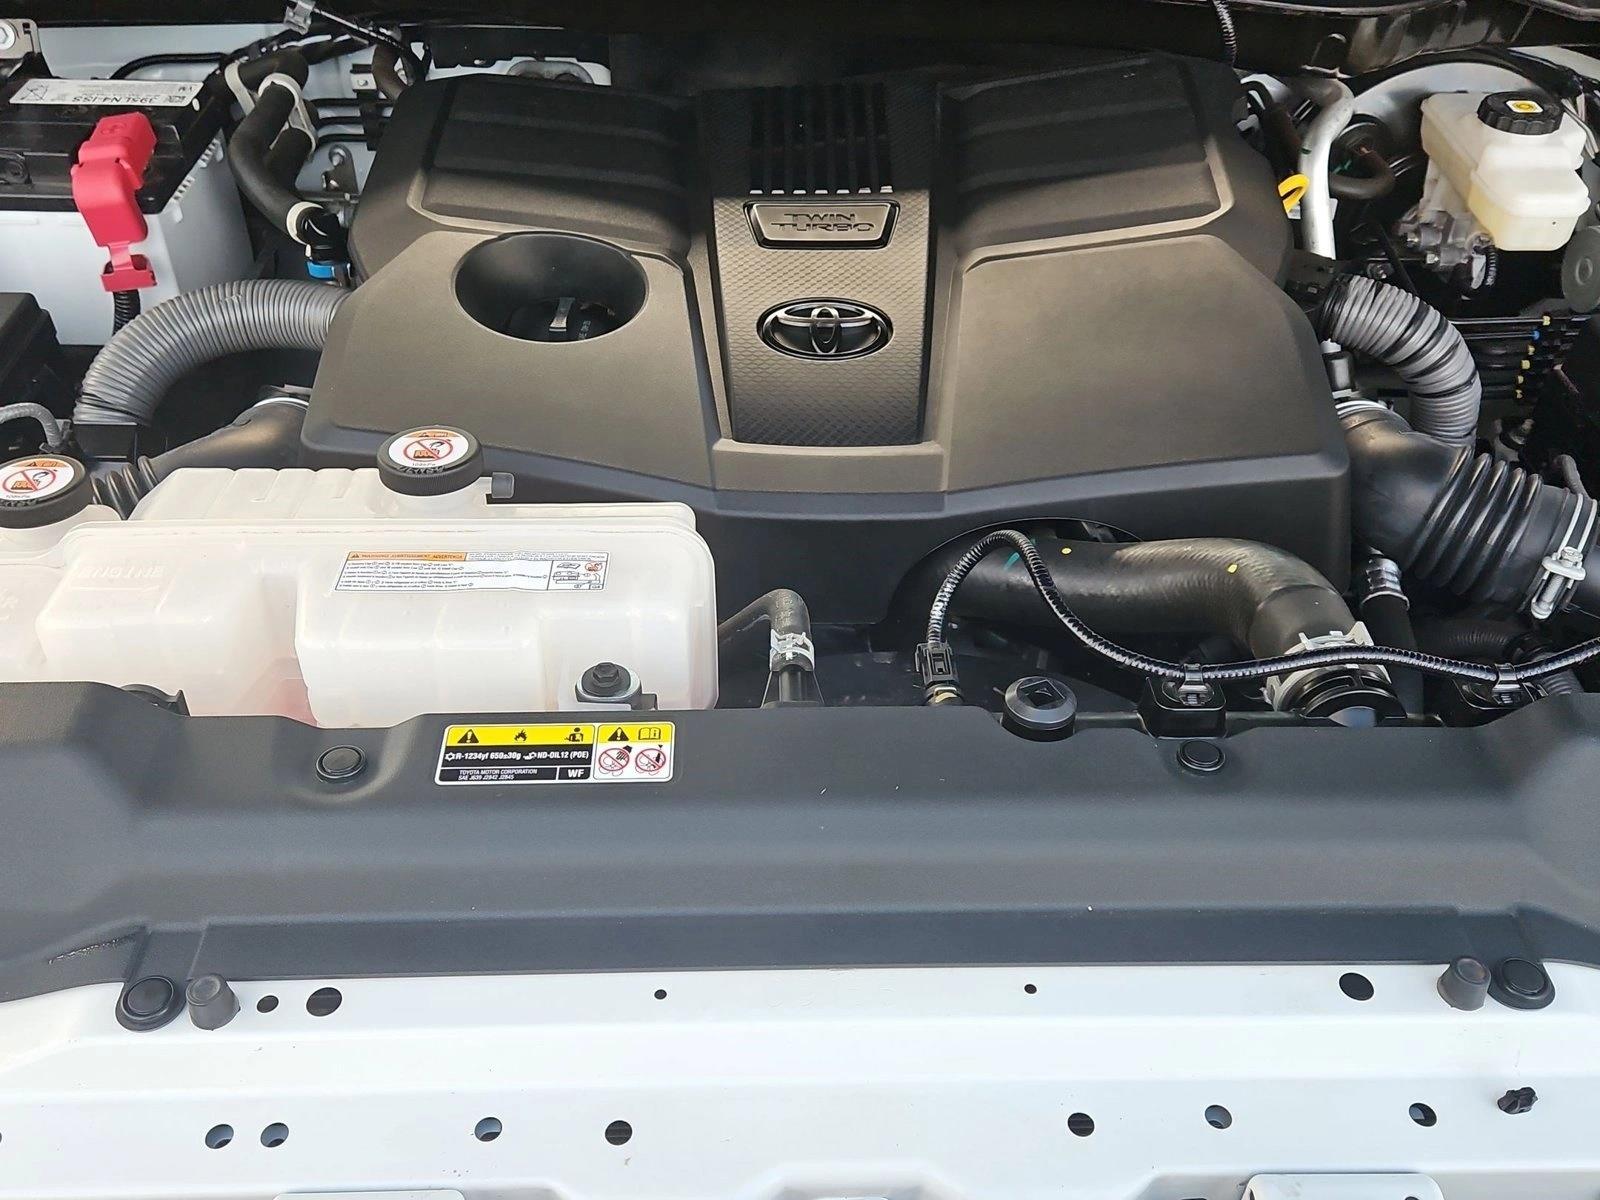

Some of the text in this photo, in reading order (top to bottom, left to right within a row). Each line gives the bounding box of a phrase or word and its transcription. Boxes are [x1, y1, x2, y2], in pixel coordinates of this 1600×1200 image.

[783, 213, 856, 222] TWIN
[770, 222, 875, 232] TURBO
[455, 752, 489, 761] R-1234yf
[569, 750, 589, 760] (POE)
[567, 769, 585, 778] WF
